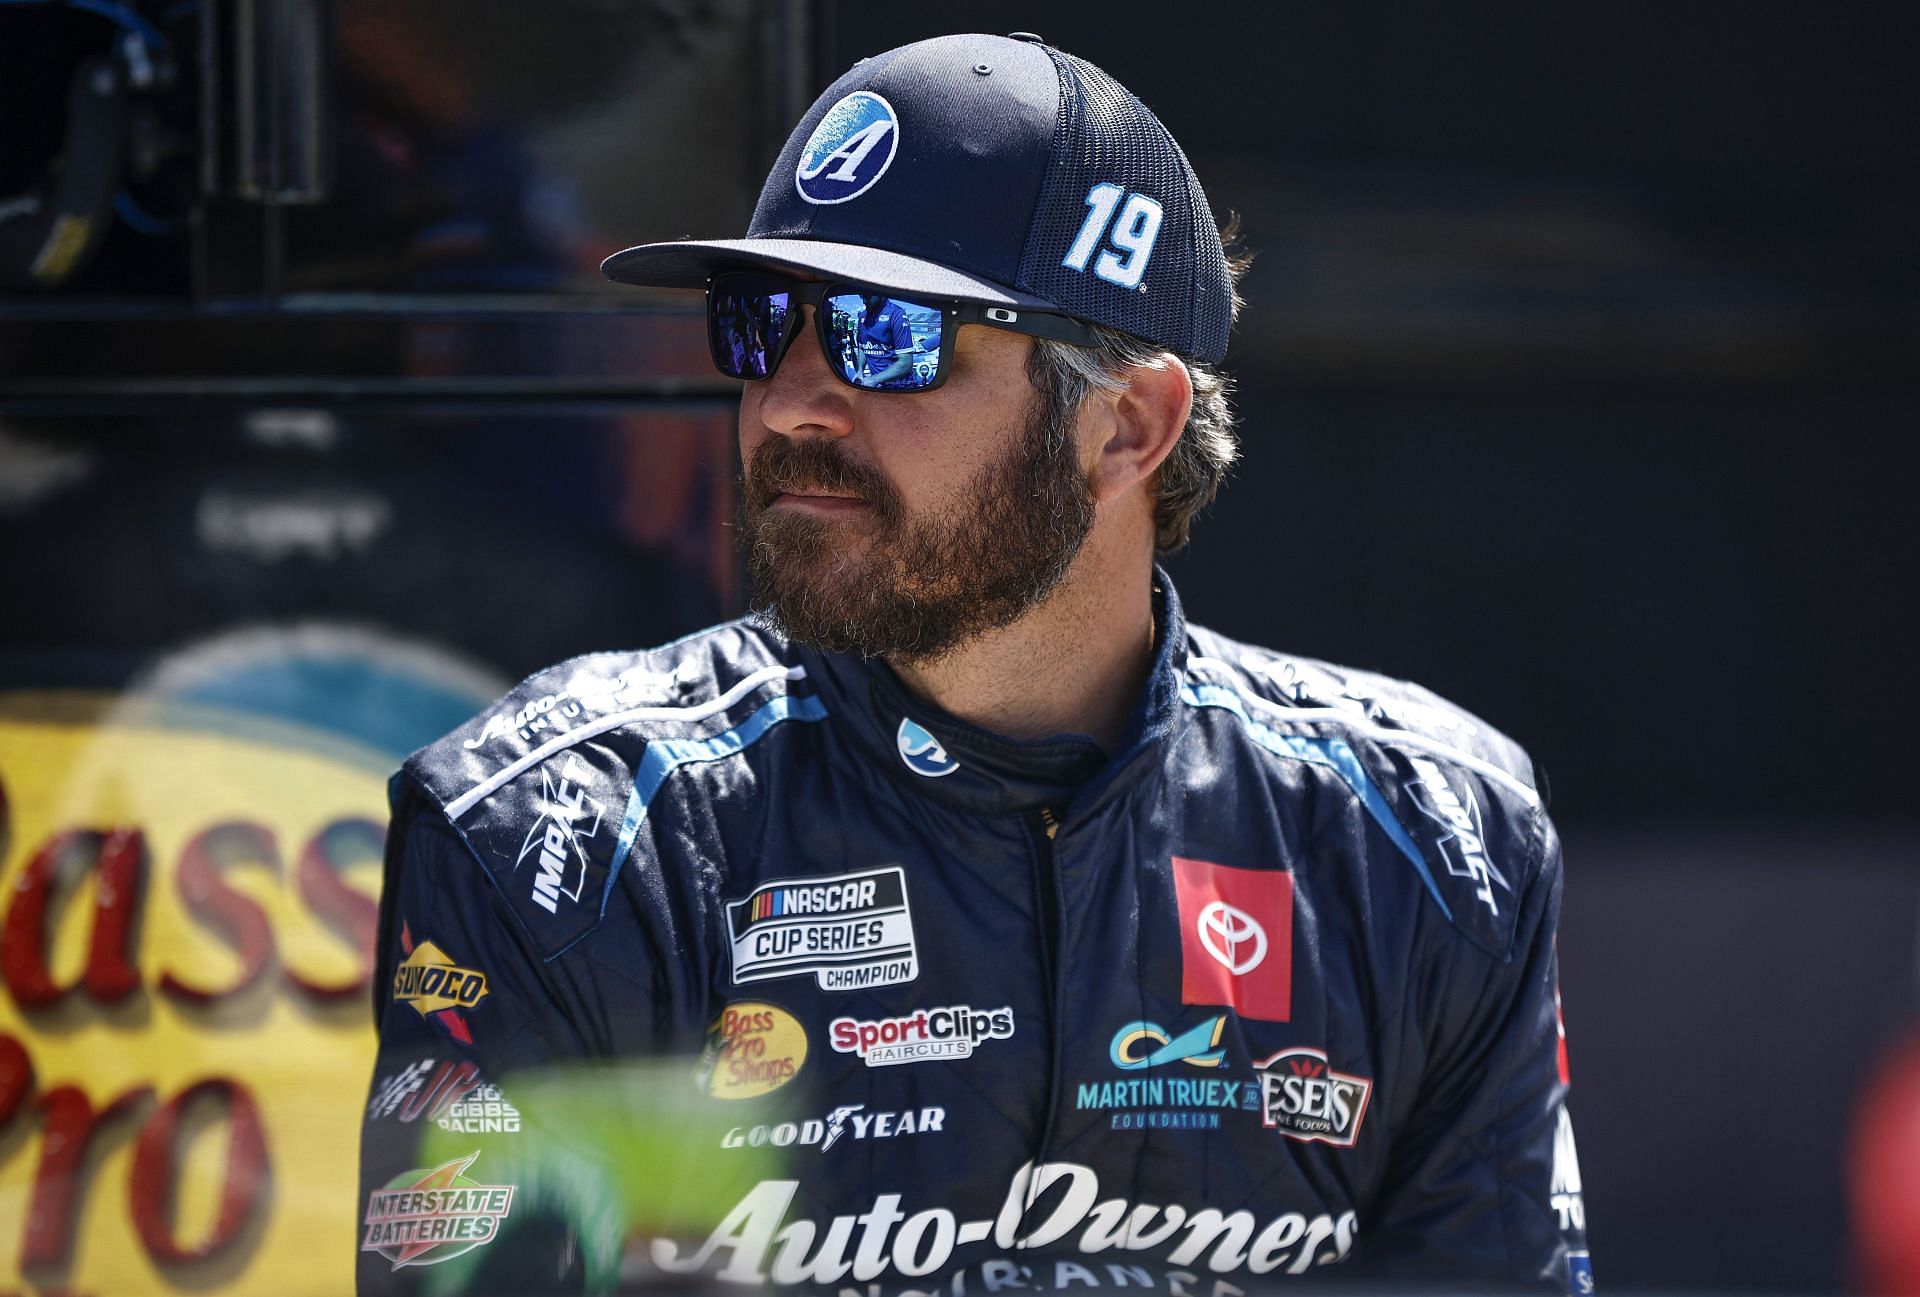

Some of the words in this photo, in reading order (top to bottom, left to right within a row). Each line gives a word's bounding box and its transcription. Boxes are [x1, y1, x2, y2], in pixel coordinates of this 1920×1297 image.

[800, 120, 893, 182] A
[1062, 181, 1163, 289] 19
[532, 755, 592, 914] IMPACT
[1409, 758, 1499, 916] IMPACT
[0, 810, 383, 1002] ass
[782, 880, 876, 915] NASCAR
[756, 929, 801, 958] CUP
[807, 921, 884, 951] SERIES
[396, 966, 484, 1004] SUNOCO
[827, 962, 911, 987] CHAMPION
[722, 1009, 775, 1036] Bass
[834, 1009, 1012, 1053] SportClips
[724, 1035, 766, 1059] Pro
[872, 1042, 967, 1062] HAIRCUTS
[450, 1103, 520, 1118] GIBBS
[1077, 1079, 1165, 1110] MARTIN
[1168, 1079, 1241, 1109] TRUEX
[437, 1118, 521, 1133] RACING
[1111, 1113, 1220, 1130] FOUNDATION
[370, 1190, 506, 1218] INTERSTATE
[370, 1217, 494, 1245] BATTERIES
[650, 1159, 1358, 1286] Auto-Owners
